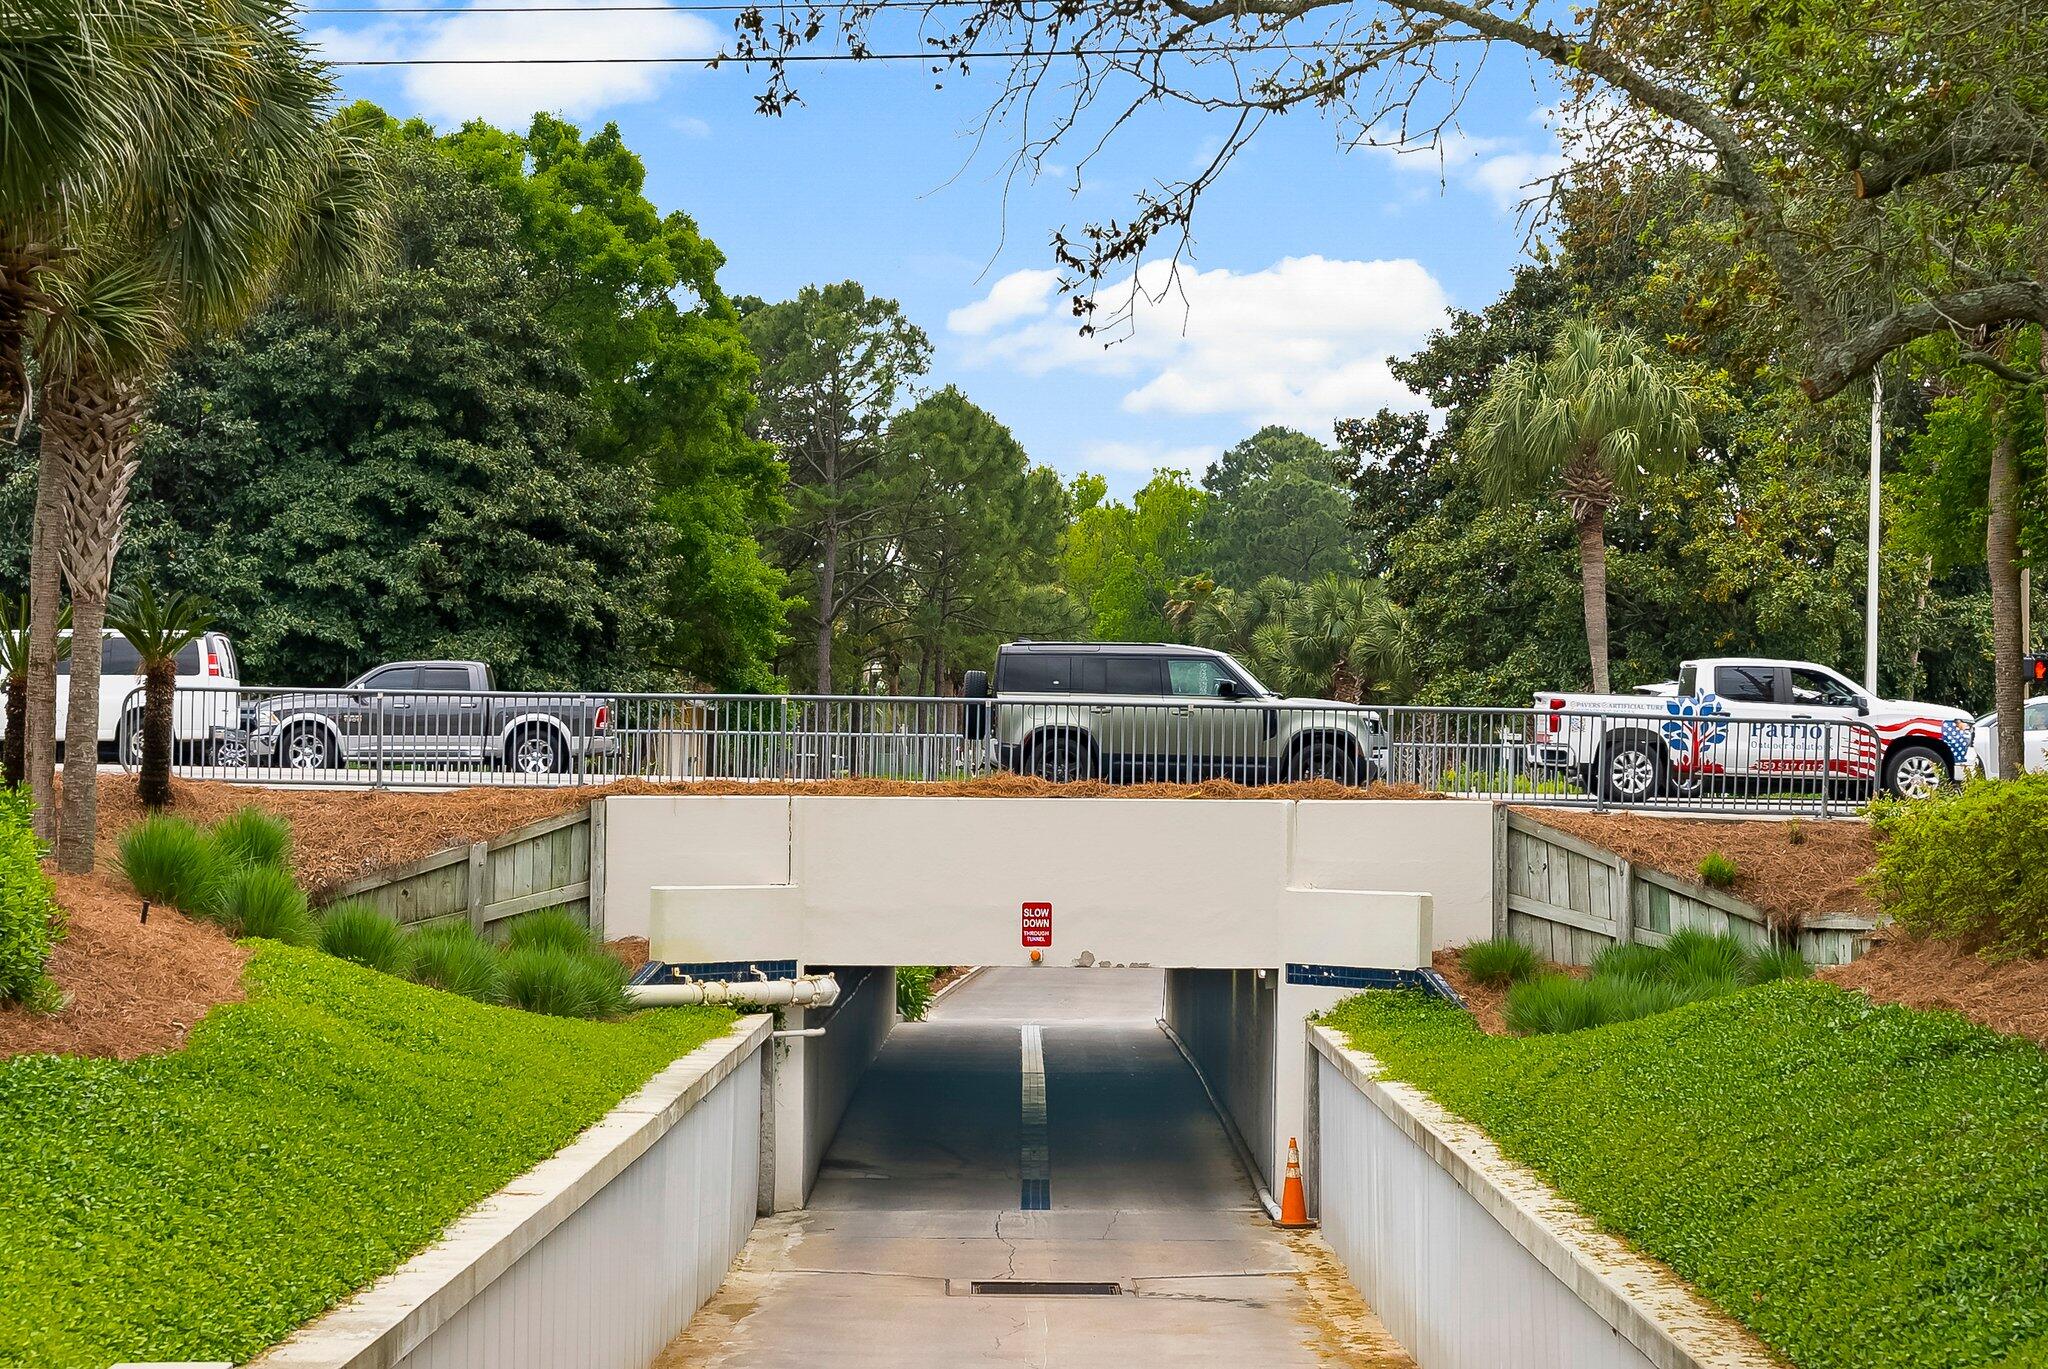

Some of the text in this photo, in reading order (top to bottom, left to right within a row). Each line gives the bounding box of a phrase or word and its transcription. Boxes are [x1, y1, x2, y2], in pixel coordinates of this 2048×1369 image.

[1751, 721, 1833, 740] Patrio
[1791, 742, 1834, 751] Solutos
[1023, 908, 1049, 917] SLOW
[1023, 919, 1049, 927] DOWN
